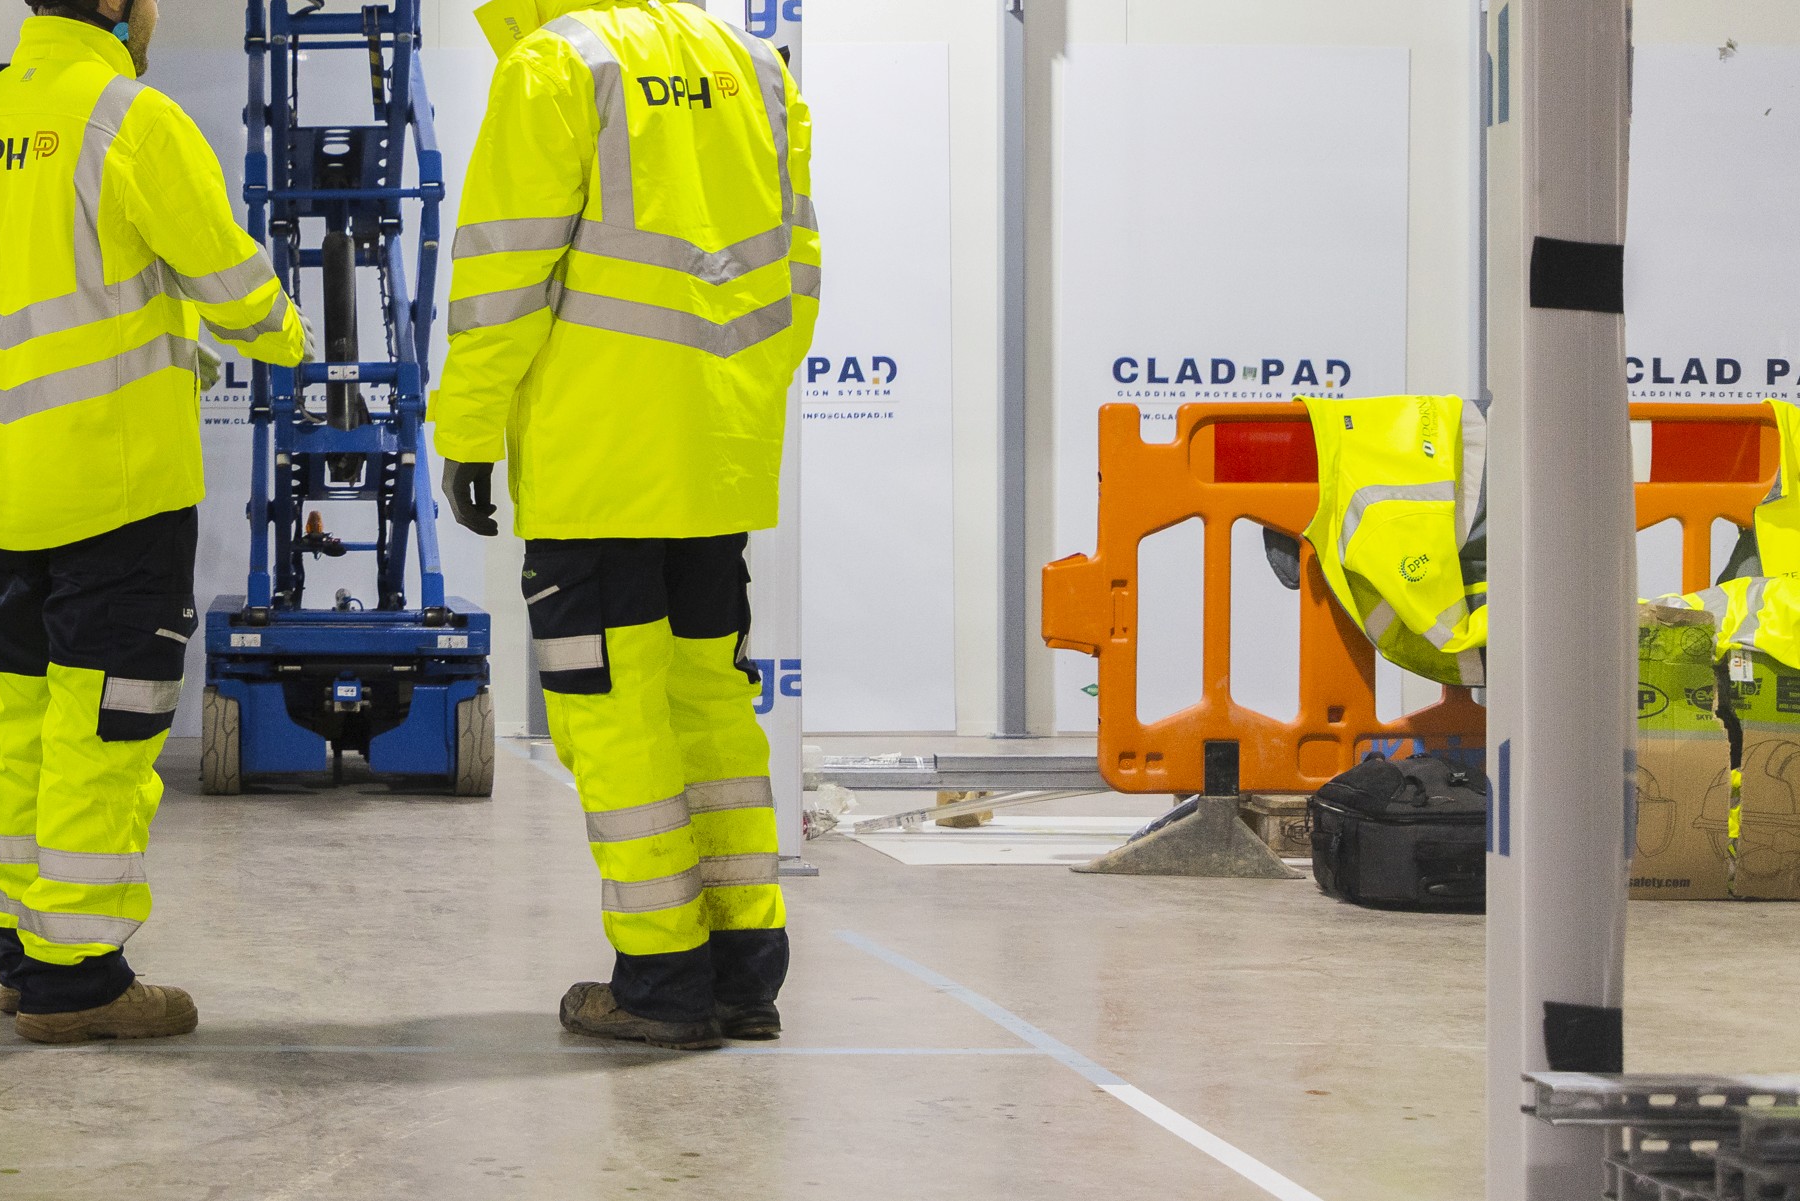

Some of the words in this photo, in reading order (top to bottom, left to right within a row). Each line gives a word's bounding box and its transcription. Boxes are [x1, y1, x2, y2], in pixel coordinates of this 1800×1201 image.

[637, 76, 712, 110] DPH
[808, 356, 898, 385] PAD
[1112, 357, 1236, 385] CLAD
[1261, 358, 1351, 388] PAD
[1627, 356, 1742, 385] CLAD
[1766, 358, 1800, 386] P
[1117, 390, 1186, 398] CLADDING
[1195, 391, 1283, 399] PROTECTION
[1700, 391, 1788, 399] PROTECTION
[802, 412, 895, 420] INFO@CLADPAD.IE
[1408, 554, 1430, 573] DPH
